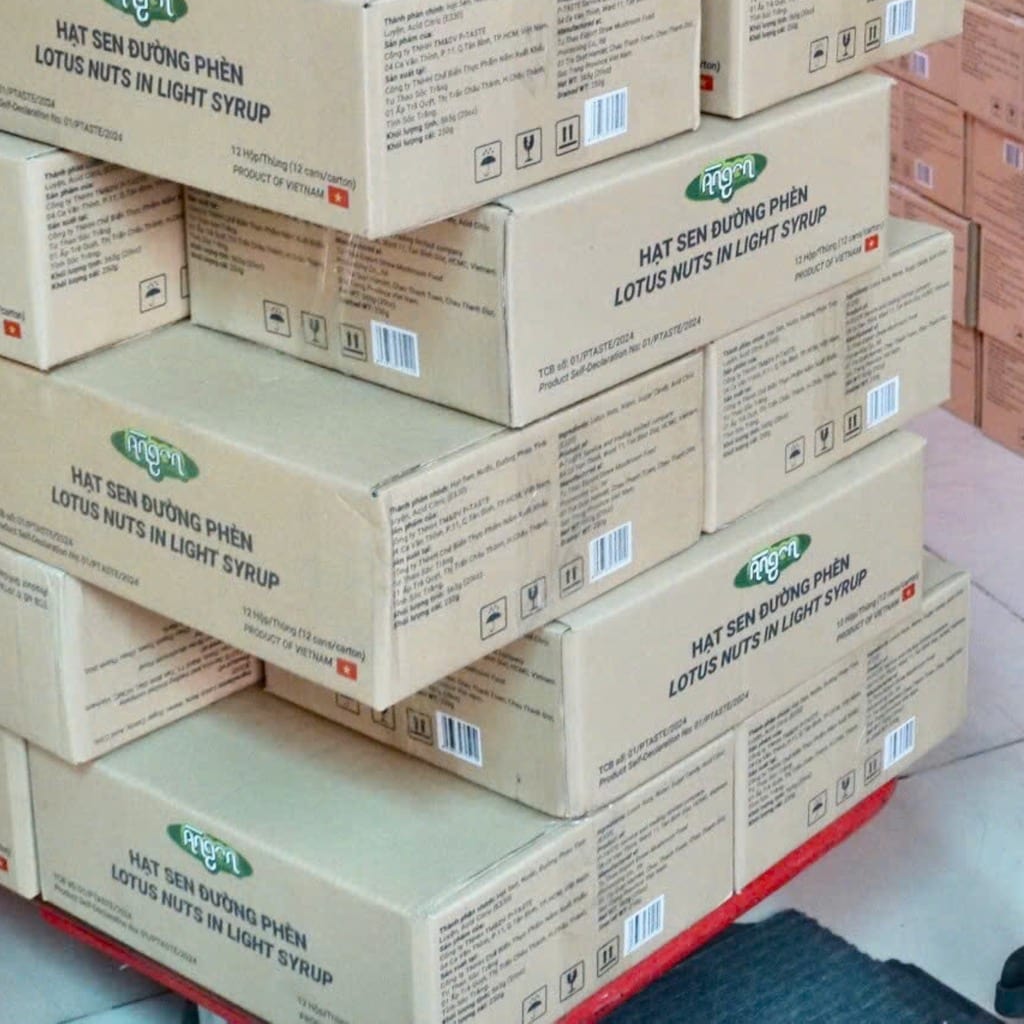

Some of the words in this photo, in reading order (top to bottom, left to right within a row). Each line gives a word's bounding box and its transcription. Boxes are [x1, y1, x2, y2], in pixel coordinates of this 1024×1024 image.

[34, 45, 84, 74] LOTUS
[87, 59, 131, 87] NUTS
[135, 71, 153, 94] IN
[157, 77, 207, 107] LIGHT
[211, 91, 270, 123] SYRUP
[55, 19, 88, 48] HẠT
[91, 28, 124, 54] SEN
[127, 38, 189, 71] ĐƯỜNG
[194, 54, 243, 85] PHÈN
[614, 269, 666, 306] LOTUS
[670, 251, 712, 283] NUTS
[715, 242, 732, 265] IN
[735, 223, 778, 257] LIGHT
[780, 204, 827, 238] SYRUP
[639, 237, 673, 268] HẠT
[676, 224, 707, 252] SEN
[711, 202, 765, 238] ĐƯỜNG
[769, 185, 808, 215] PHÈN
[70, 465, 102, 495] HẠT
[106, 480, 138, 507] SEN
[51, 486, 99, 520] LOTUS
[103, 507, 145, 538] NUTS
[149, 525, 166, 547] IN
[170, 533, 218, 566] LIGHT
[222, 554, 279, 588] SYRUP
[668, 655, 717, 697] LOTUS
[720, 631, 760, 666] NUTS
[763, 619, 779, 642] IN
[781, 594, 822, 632] LIGHT
[824, 568, 867, 606] SYRUP
[691, 626, 723, 659] HẠT
[726, 608, 755, 637] SEN
[758, 578, 810, 619] ĐƯỜNG
[813, 554, 850, 588] PHÈN
[128, 849, 159, 878] HẠT
[164, 866, 194, 894] SEN
[111, 864, 156, 900] LOTUS
[161, 890, 202, 923] NUTS
[206, 912, 223, 933] IN
[226, 923, 273, 958] LIGHT
[277, 949, 333, 985] SYRUP
